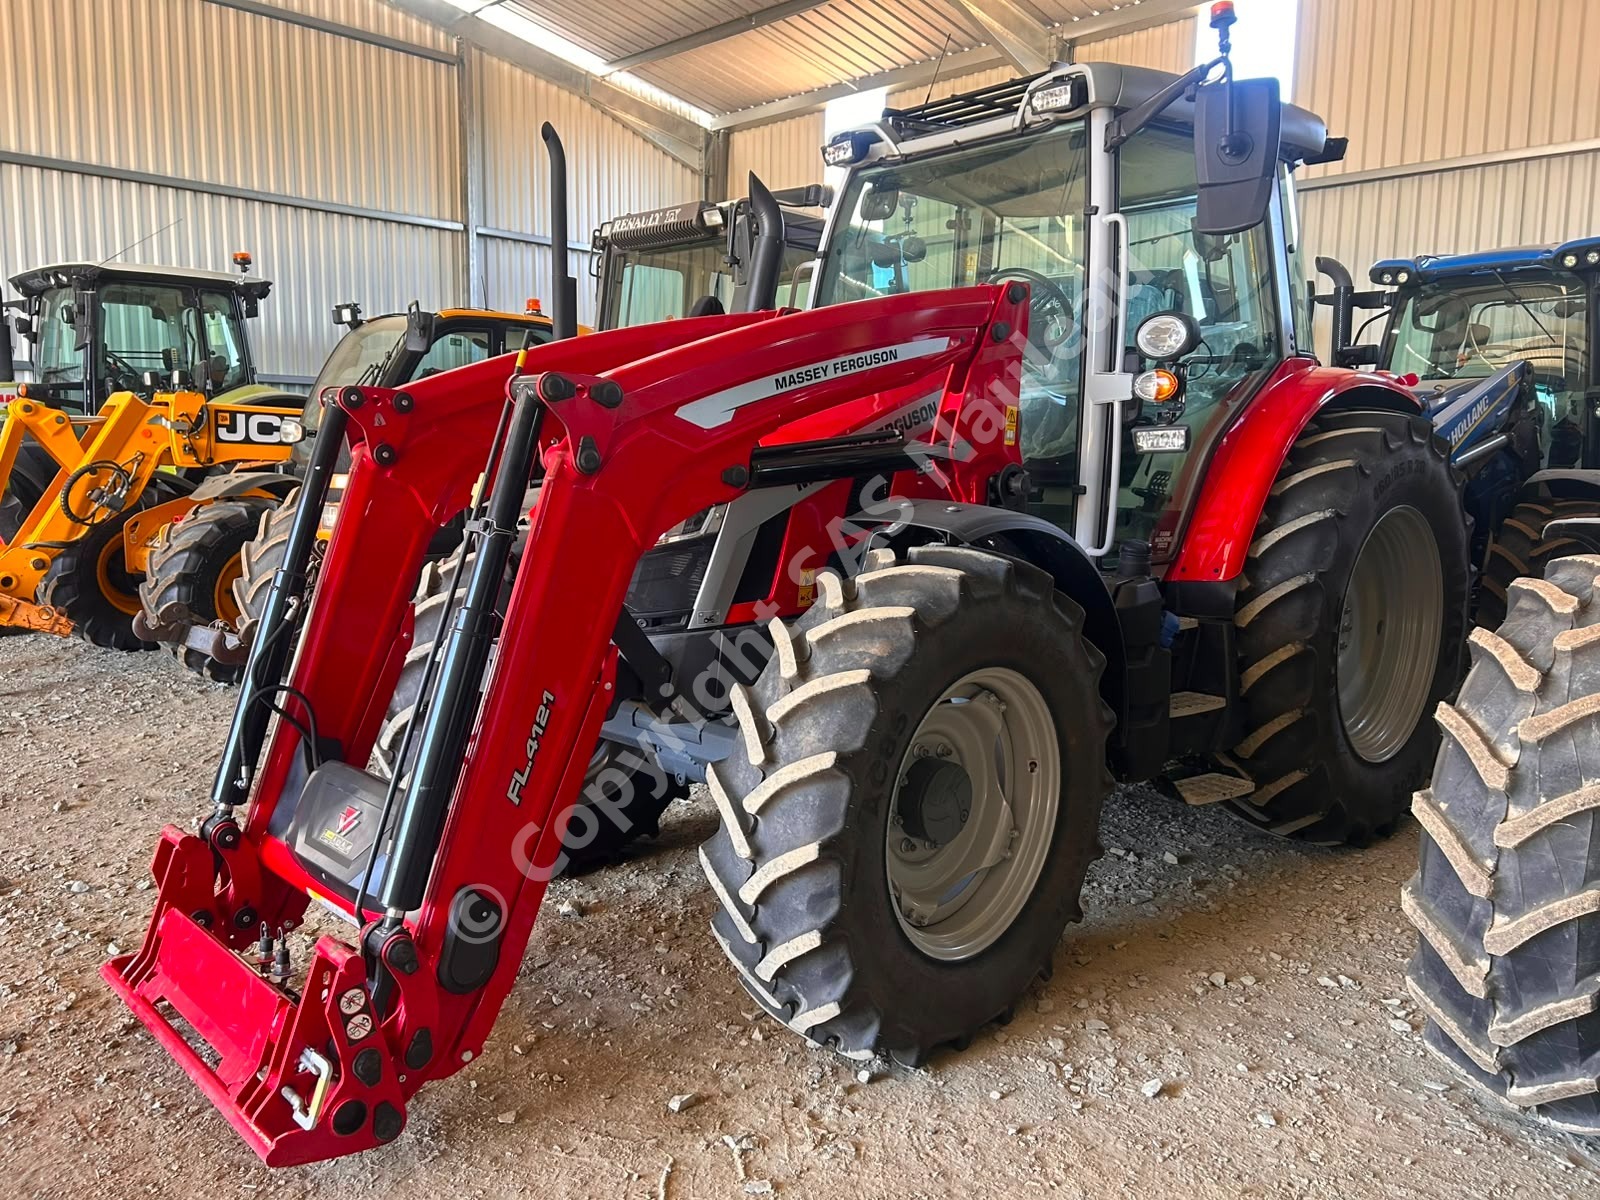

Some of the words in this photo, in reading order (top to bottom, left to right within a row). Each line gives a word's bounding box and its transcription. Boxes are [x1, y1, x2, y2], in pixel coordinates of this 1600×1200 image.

[612, 212, 663, 233] RENAULT
[774, 365, 829, 391] MASSEY
[833, 348, 899, 375] FERGUSON
[217, 412, 300, 443] JC
[864, 401, 938, 443] GUSON
[506, 690, 555, 806] FL.4121
